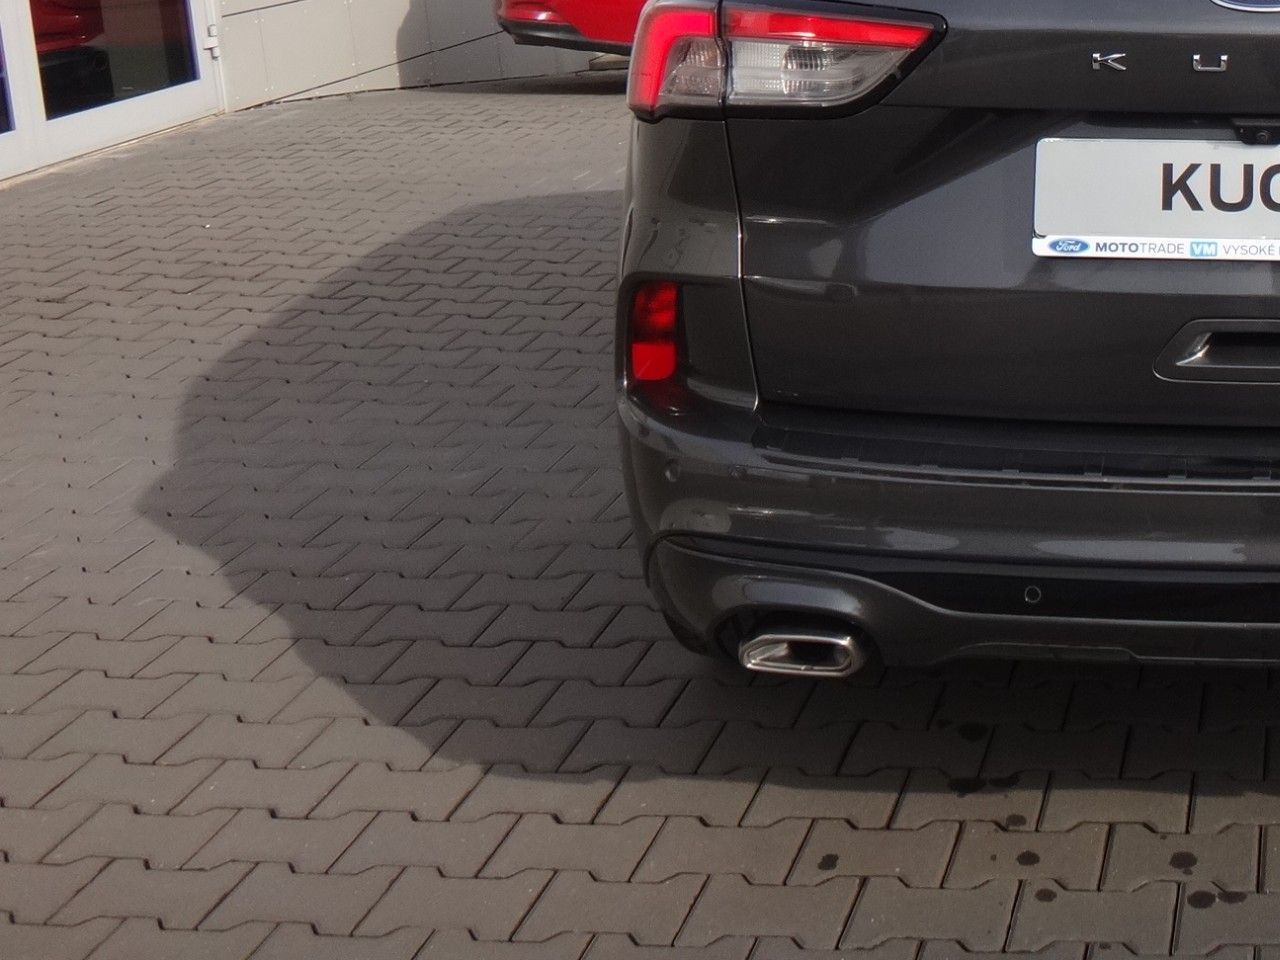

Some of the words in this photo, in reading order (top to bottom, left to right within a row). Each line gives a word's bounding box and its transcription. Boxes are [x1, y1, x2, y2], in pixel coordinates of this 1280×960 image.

[1055, 240, 1082, 252] Ford
[1095, 242, 1185, 254] MOTOTRADE
[1192, 243, 1216, 256] VM
[1223, 243, 1275, 256] VYSOKÉ
